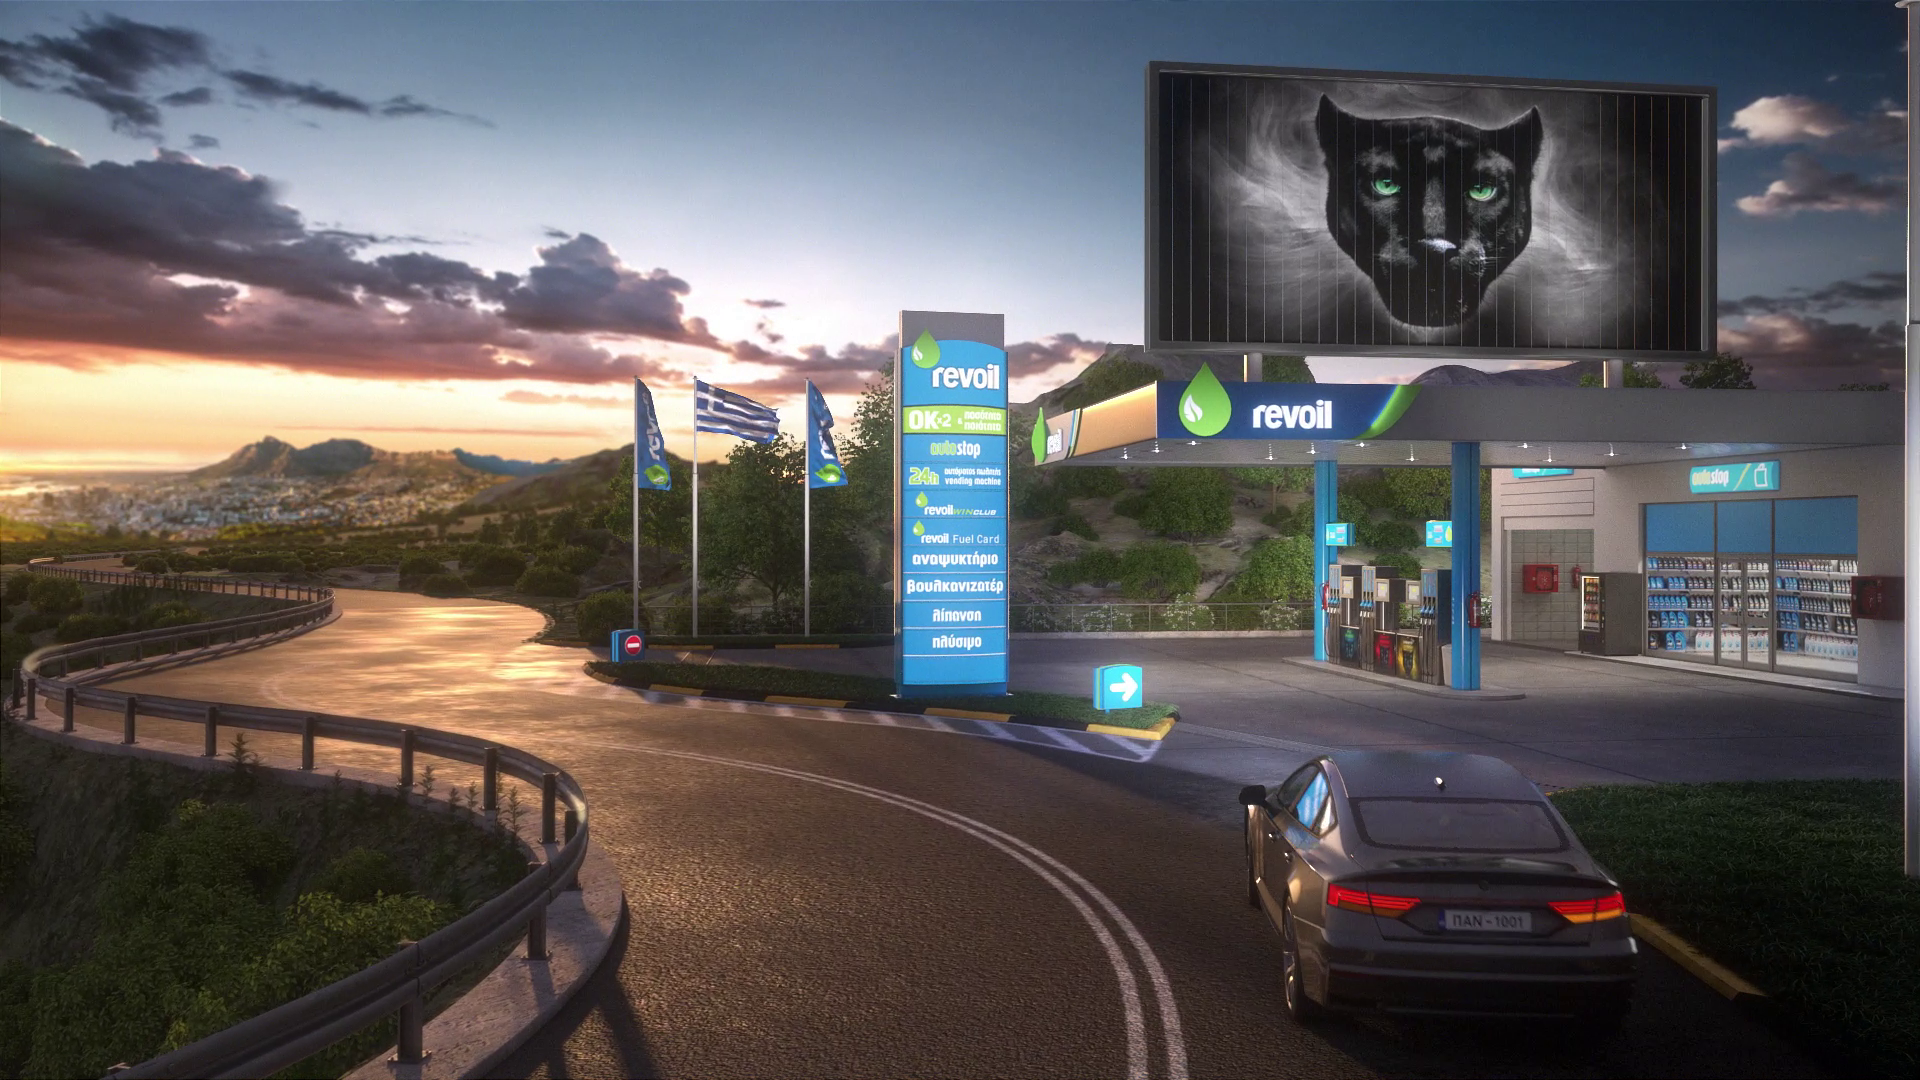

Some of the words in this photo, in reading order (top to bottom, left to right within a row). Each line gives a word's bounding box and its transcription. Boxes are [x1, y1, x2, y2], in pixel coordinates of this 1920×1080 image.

[932, 364, 999, 390] revoil
[1252, 399, 1332, 429] revoil
[909, 467, 939, 485] 24h
[944, 477, 973, 486] vending
[974, 477, 1002, 486] machine
[920, 532, 949, 544] revoil
[953, 534, 974, 544] Fuel
[976, 534, 1000, 544] Card
[912, 550, 998, 567] αναψυκτήριο
[906, 578, 1004, 595] βουλκανιζατέρ
[932, 607, 982, 622] λίπανση
[932, 634, 982, 651] πλύσιμο
